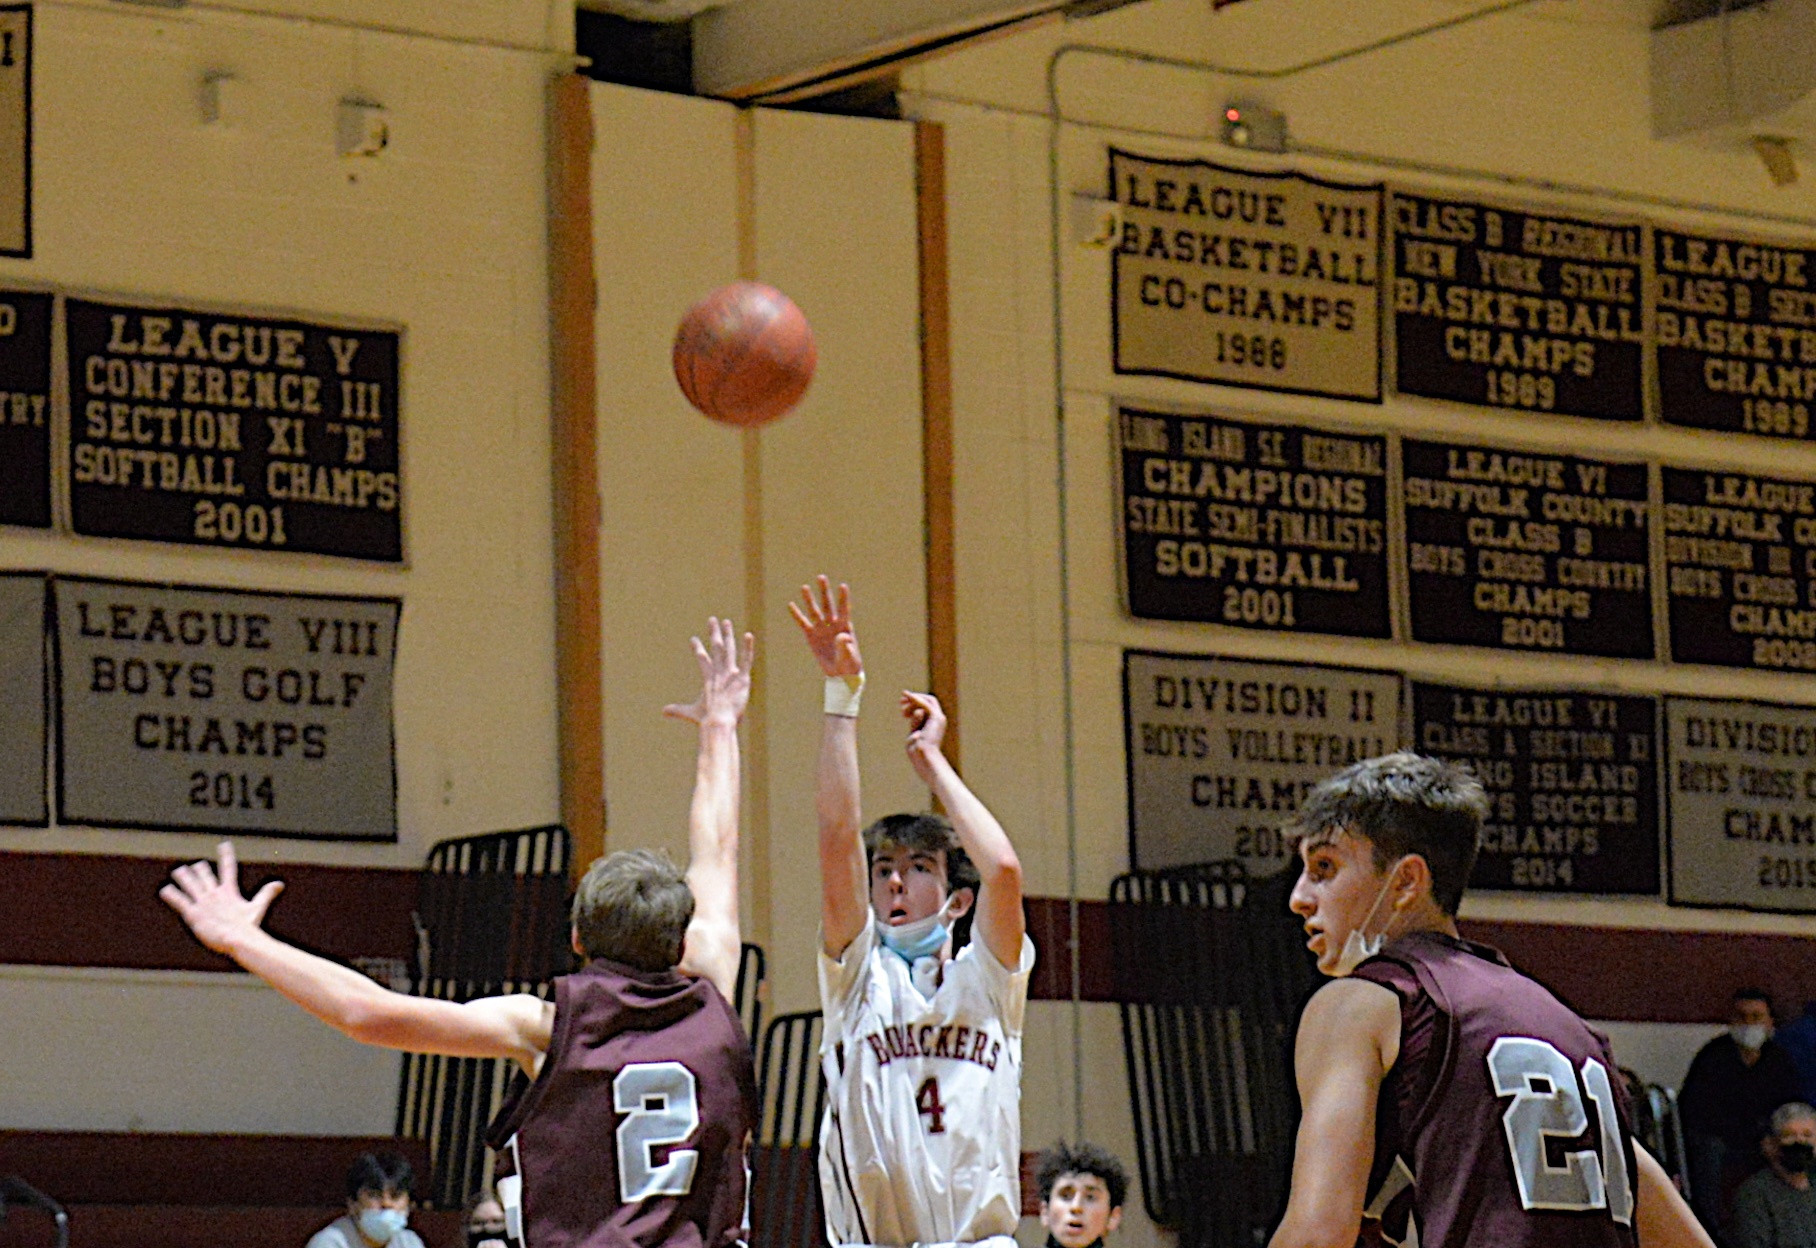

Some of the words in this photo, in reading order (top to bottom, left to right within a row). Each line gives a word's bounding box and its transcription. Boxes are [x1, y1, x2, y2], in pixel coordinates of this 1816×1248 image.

[1128, 173, 1286, 227] LEAGUE
[1315, 202, 1368, 240] VII
[1395, 198, 1477, 242] CLASS
[1119, 221, 1375, 287] BASKETBALL
[1661, 235, 1808, 287] LEAGUE
[1560, 262, 1636, 304] STATE
[1394, 277, 1643, 341] BASKETBALL
[106, 314, 306, 370] LEAGUE
[327, 335, 359, 376] V
[1445, 325, 1596, 378] CHAMPS
[85, 355, 322, 415] CONFERENCE
[340, 380, 382, 422] III
[85, 399, 244, 451] SECTION
[266, 415, 306, 457] XI
[74, 442, 246, 496] SOFTBALL
[266, 460, 398, 511] CHAMPS
[1143, 457, 1368, 514] CHAMPIONS
[1447, 450, 1565, 490] LEAGUE
[1575, 464, 1607, 495] VI
[1704, 475, 1815, 514] LEAGUE
[193, 499, 287, 545] 2001
[1127, 494, 1200, 537] STATE
[1404, 476, 1530, 519] SUFFOLK
[1541, 492, 1648, 528] COUNTY
[1466, 517, 1561, 553] CLASS
[1155, 538, 1361, 592] SOFTBALL
[1222, 584, 1297, 627] 2001
[1473, 582, 1592, 620] CHAMPS
[78, 601, 273, 651] LEAGUE
[298, 616, 380, 657] VIII
[1501, 615, 1565, 648] 2001
[90, 656, 215, 700] BOYS
[242, 666, 367, 709] GOLF
[1153, 675, 1327, 719] DIVISION
[1350, 689, 1374, 722] II
[1454, 695, 1574, 726] LEAGUE
[1588, 699, 1618, 729] VI
[134, 713, 329, 760] CHAMPS
[1141, 722, 1210, 759] BOYS
[1686, 716, 1816, 757] DIVISIO
[189, 771, 275, 811] 2014
[1530, 761, 1640, 792] ISLAND
[1532, 793, 1638, 825] SOCCER
[1235, 825, 1288, 859] 201
[1483, 823, 1600, 856] CHAMPS
[1511, 856, 1575, 887] 2014
[915, 1077, 946, 1134] 4
[613, 1061, 700, 1203] 2
[1486, 1036, 1634, 1227] 21
